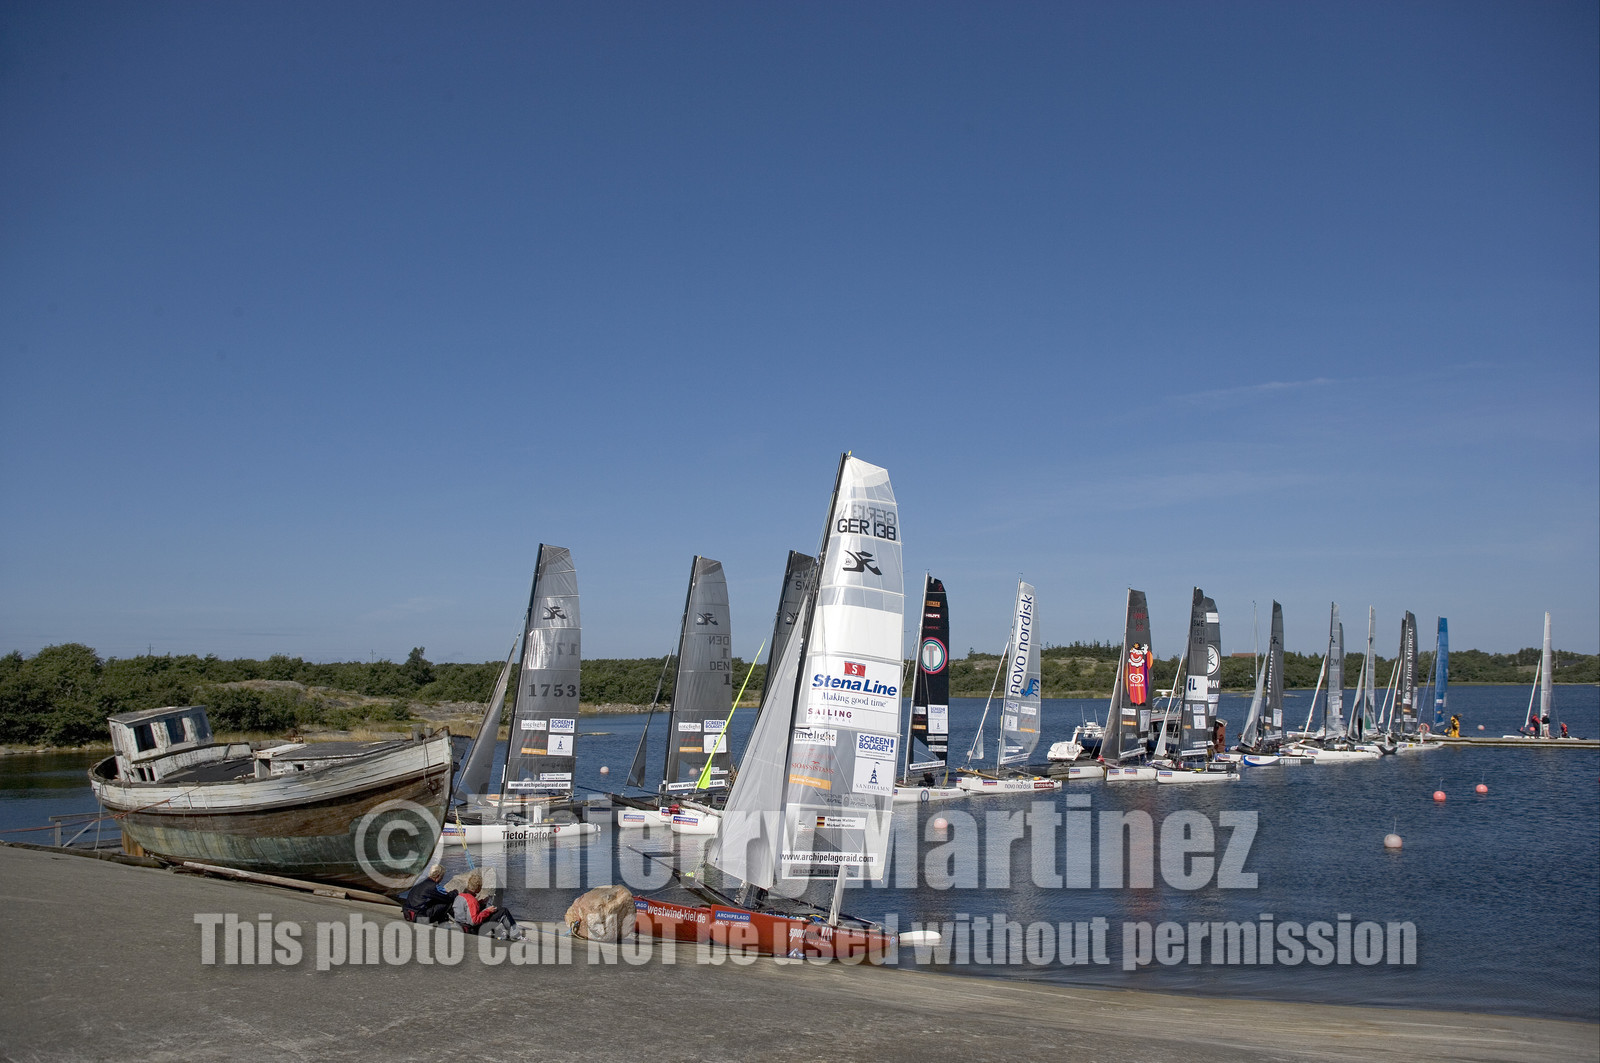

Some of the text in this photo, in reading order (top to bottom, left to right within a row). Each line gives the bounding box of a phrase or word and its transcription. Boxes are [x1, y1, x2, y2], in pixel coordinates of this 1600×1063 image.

[837, 518, 896, 541] GER 138
[1010, 656, 1026, 694] novo
[1018, 594, 1033, 652] nordisk
[709, 661, 730, 671] DEN
[851, 664, 858, 674] S
[723, 673, 731, 686] 1
[812, 673, 897, 696] Stena Line
[528, 684, 577, 698] 1753
[822, 691, 850, 704] Making
[851, 698, 869, 707] good
[807, 707, 852, 719] SAILING
[859, 734, 890, 746] SCREEN
[856, 783, 890, 792] SANDHAMN
[502, 830, 552, 840] TietoEnator
[779, 852, 874, 864] www.archipelagoraid.com
[647, 905, 706, 924] westwind-kiel.de
[717, 912, 750, 921] ARCHIPELAGO
